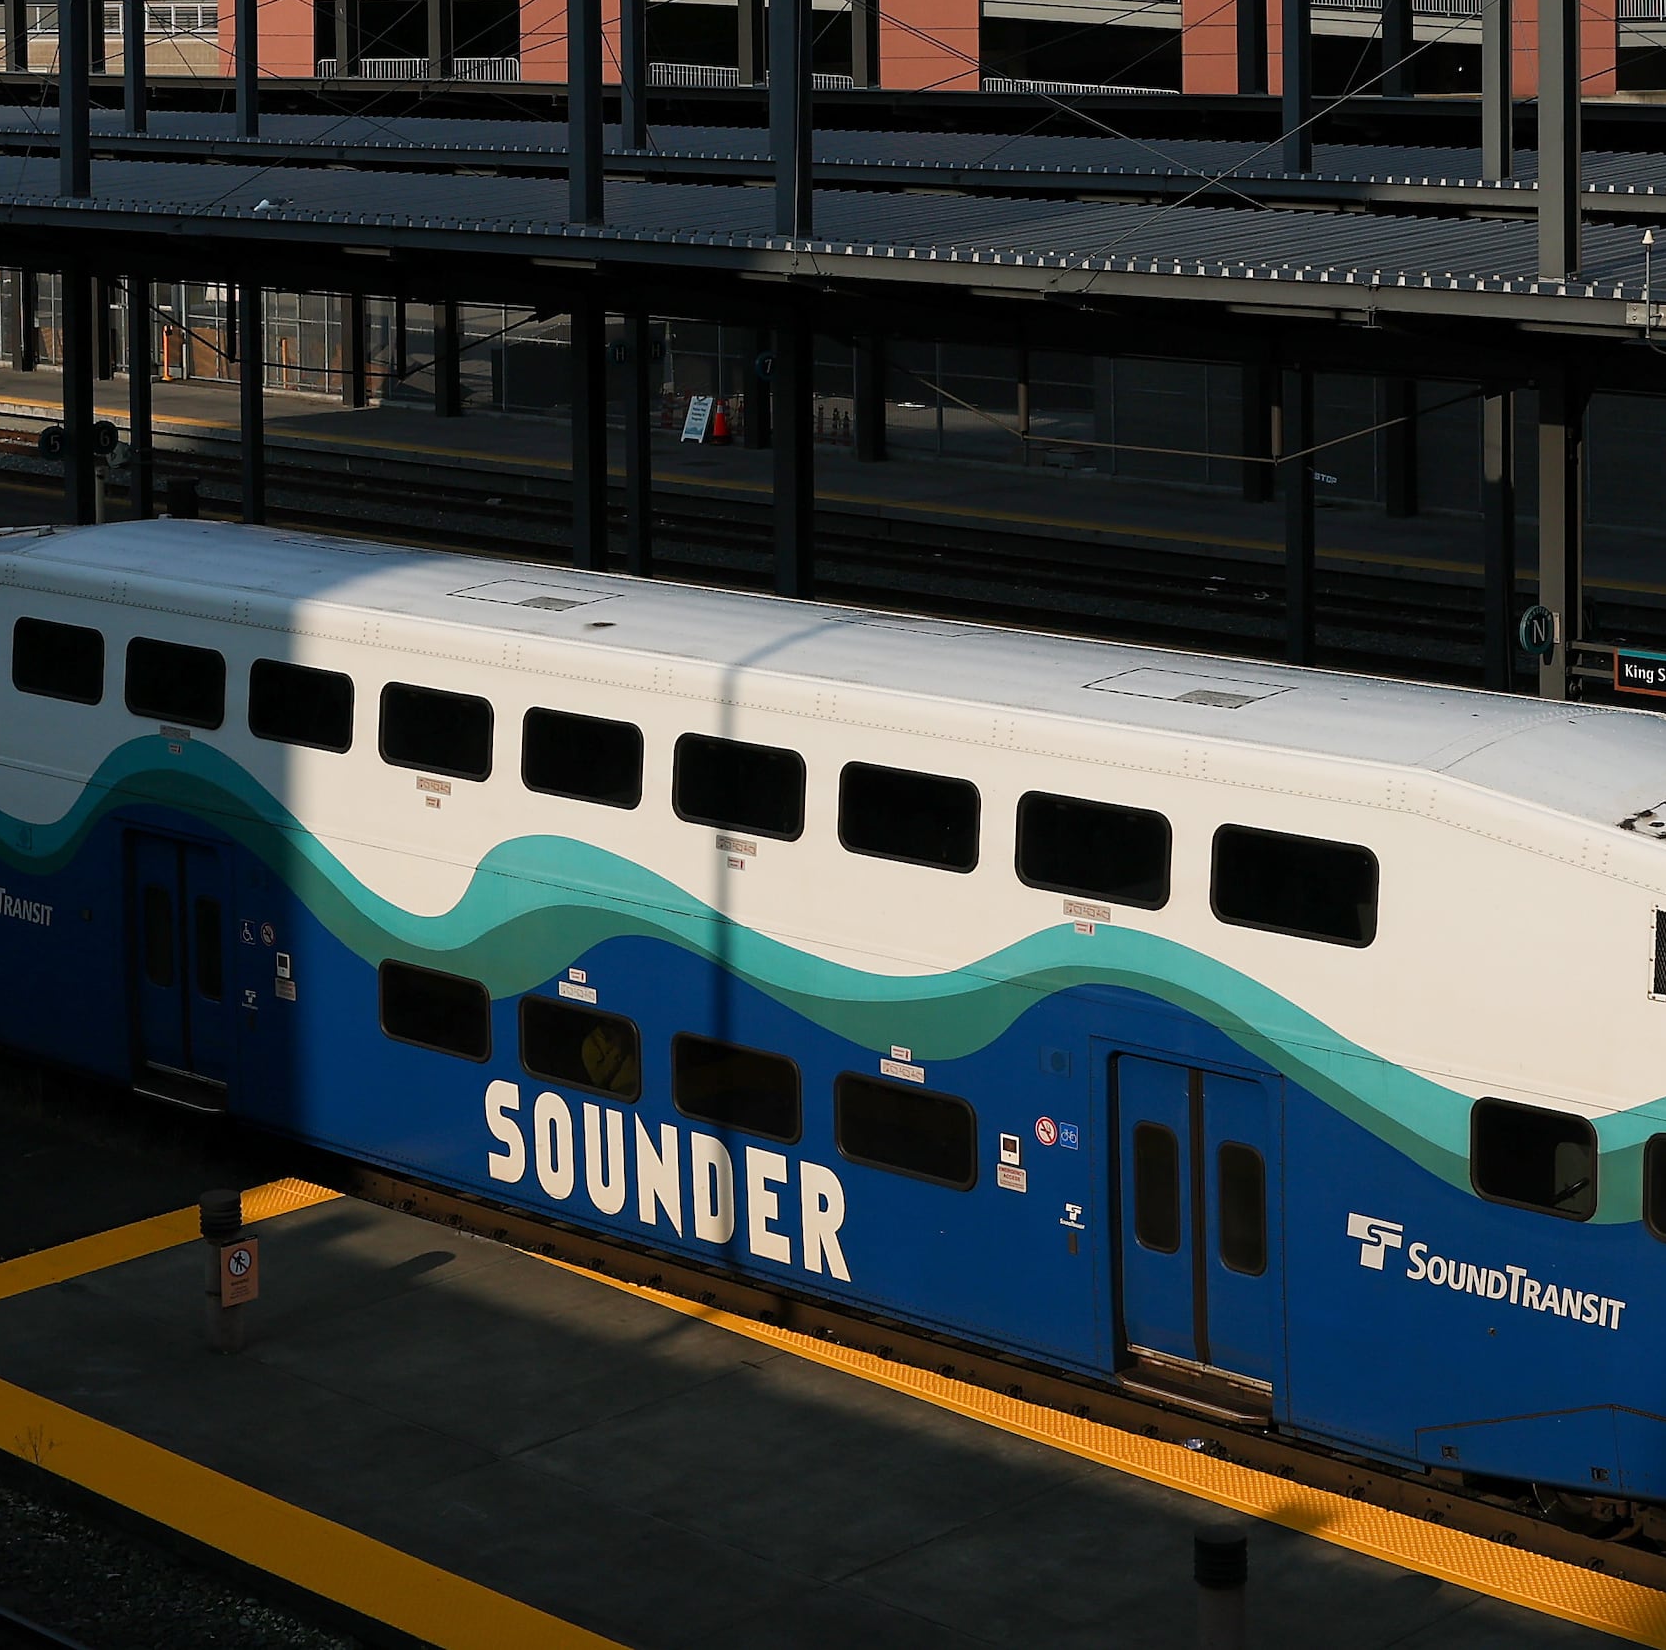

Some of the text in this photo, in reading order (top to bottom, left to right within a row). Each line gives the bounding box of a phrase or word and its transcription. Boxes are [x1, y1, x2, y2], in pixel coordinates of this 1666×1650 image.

[49, 439, 61, 453] 5
[100, 432, 111, 447] 6
[1313, 472, 1338, 484] STOP
[1533, 617, 1545, 643] N
[1624, 663, 1654, 683] King
[485, 1079, 852, 1283] SOUNDER
